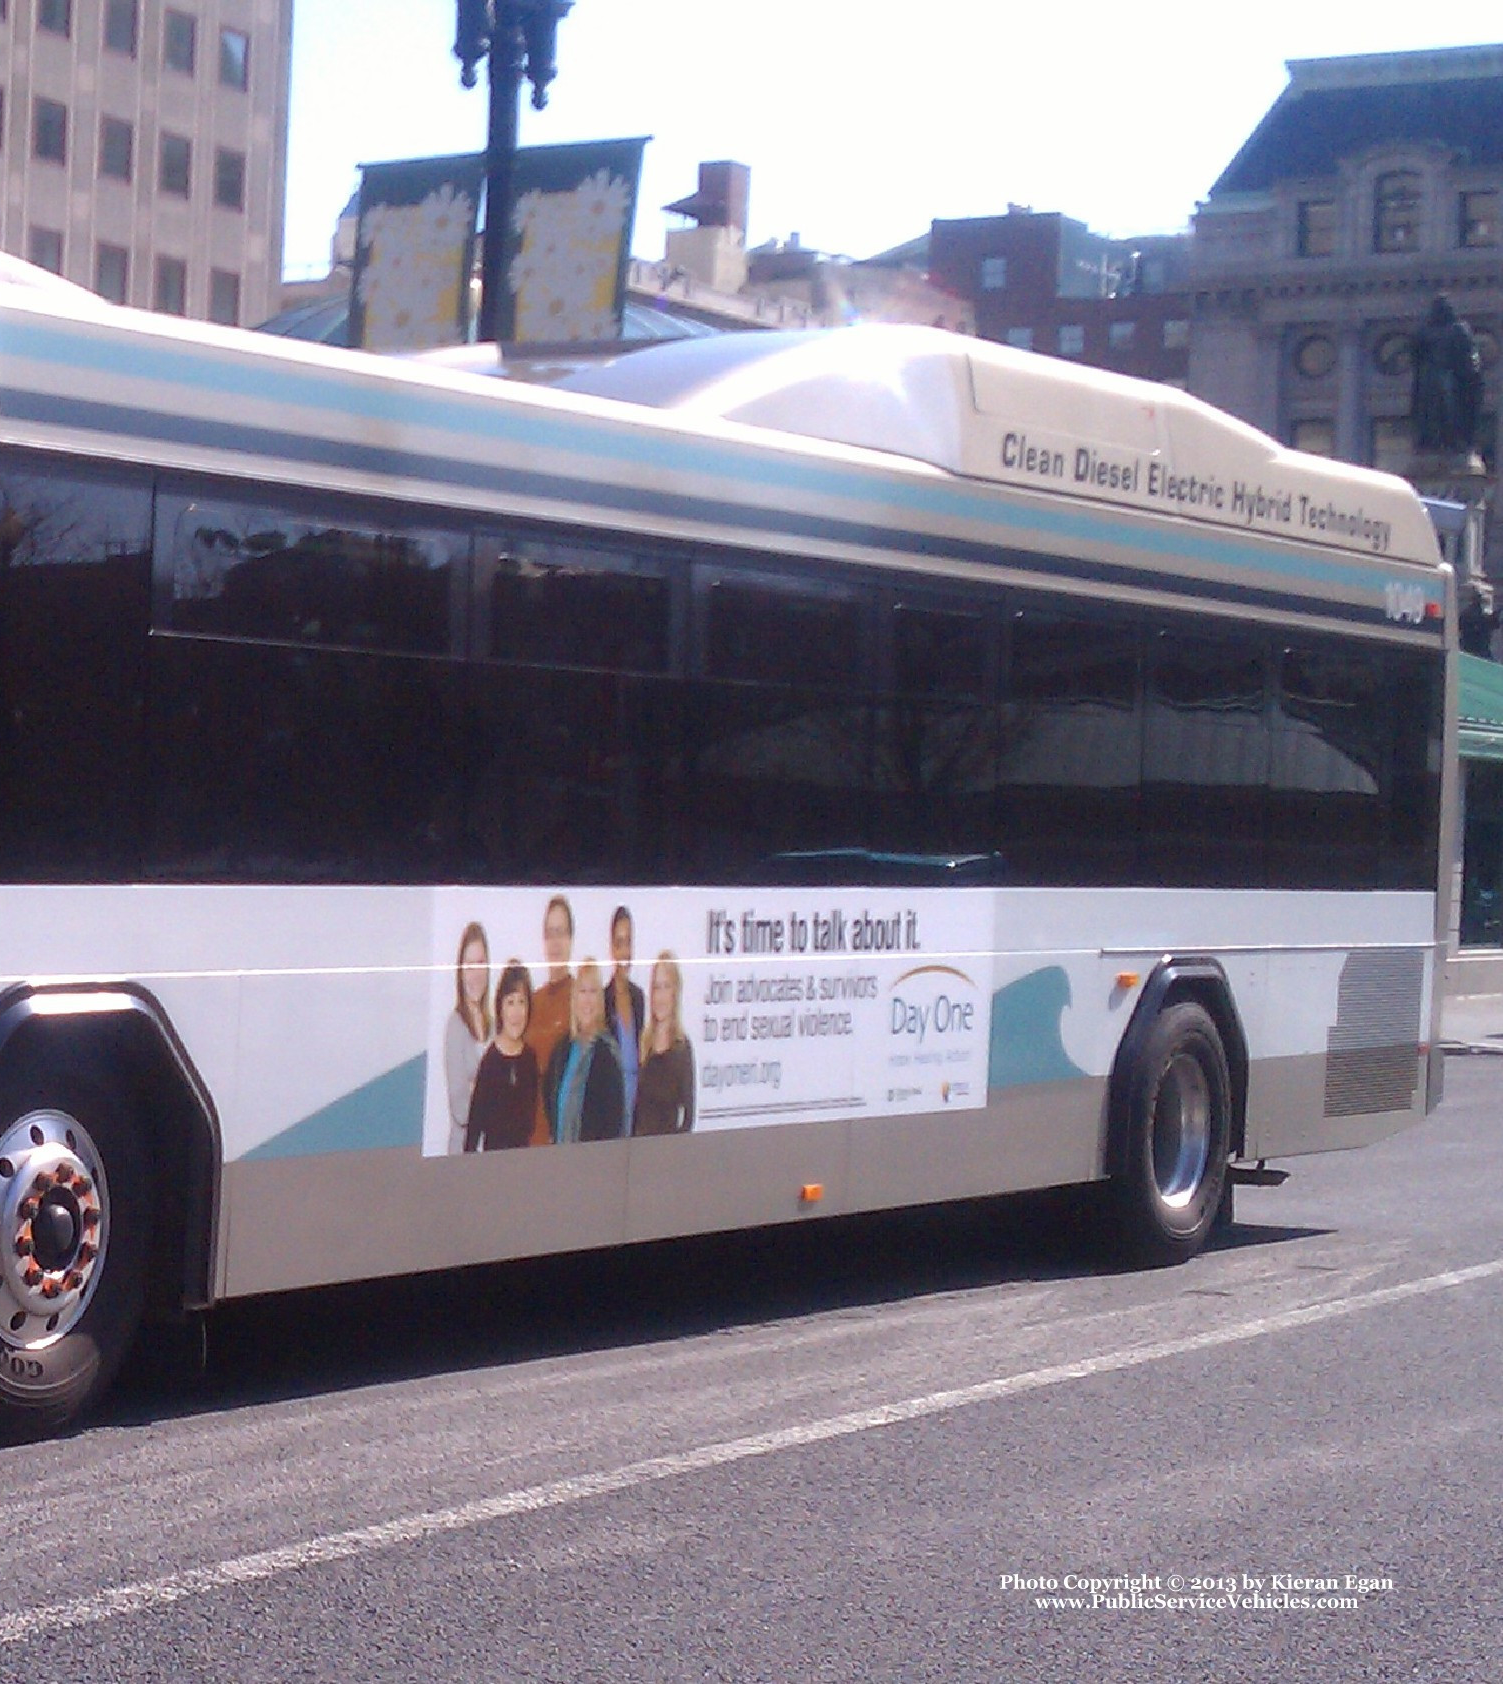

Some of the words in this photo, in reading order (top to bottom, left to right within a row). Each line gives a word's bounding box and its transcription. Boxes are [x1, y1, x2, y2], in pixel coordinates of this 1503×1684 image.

[1002, 432, 1065, 478] Clean
[1074, 447, 1140, 492] Diesel
[1148, 462, 1225, 507] Electric
[1231, 479, 1293, 525] Hybrid
[1299, 495, 1392, 551] Technology
[706, 908, 736, 953] It's
[741, 909, 784, 953] time
[791, 910, 808, 952] to
[813, 908, 847, 951] talk
[852, 910, 901, 951] about
[905, 908, 921, 950] it.
[704, 974, 733, 1005] Join
[737, 974, 802, 1003] advocates
[805, 976, 816, 1001] &
[819, 974, 879, 999] survivors
[704, 1011, 718, 1042] to
[720, 1009, 749, 1041] end
[751, 1008, 794, 1040] sexual
[891, 996, 930, 1045] Day
[934, 994, 974, 1033] One
